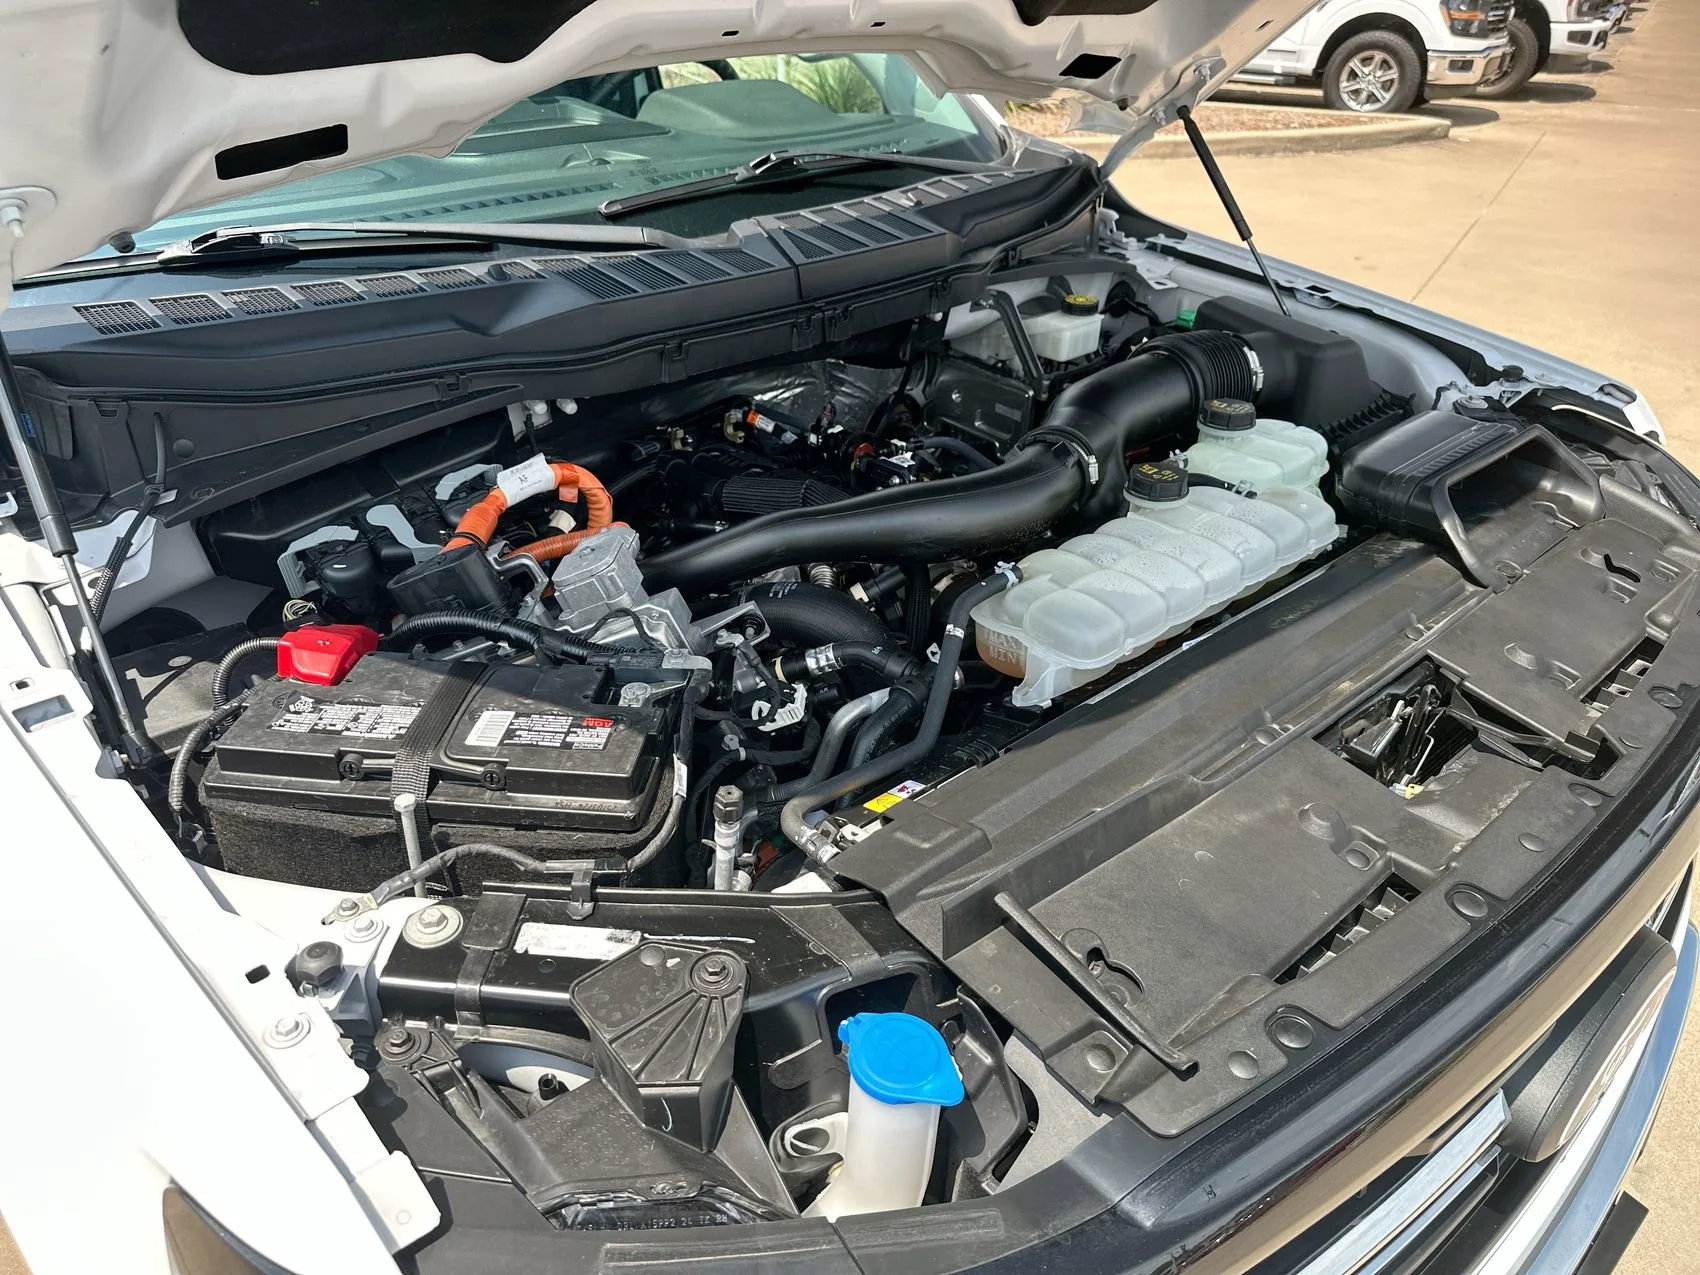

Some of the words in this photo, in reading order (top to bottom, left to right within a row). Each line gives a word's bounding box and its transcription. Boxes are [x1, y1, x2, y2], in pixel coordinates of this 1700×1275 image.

[518, 474, 529, 485] AF
[988, 630, 1017, 649] MAX
[989, 645, 1016, 665] MIN
